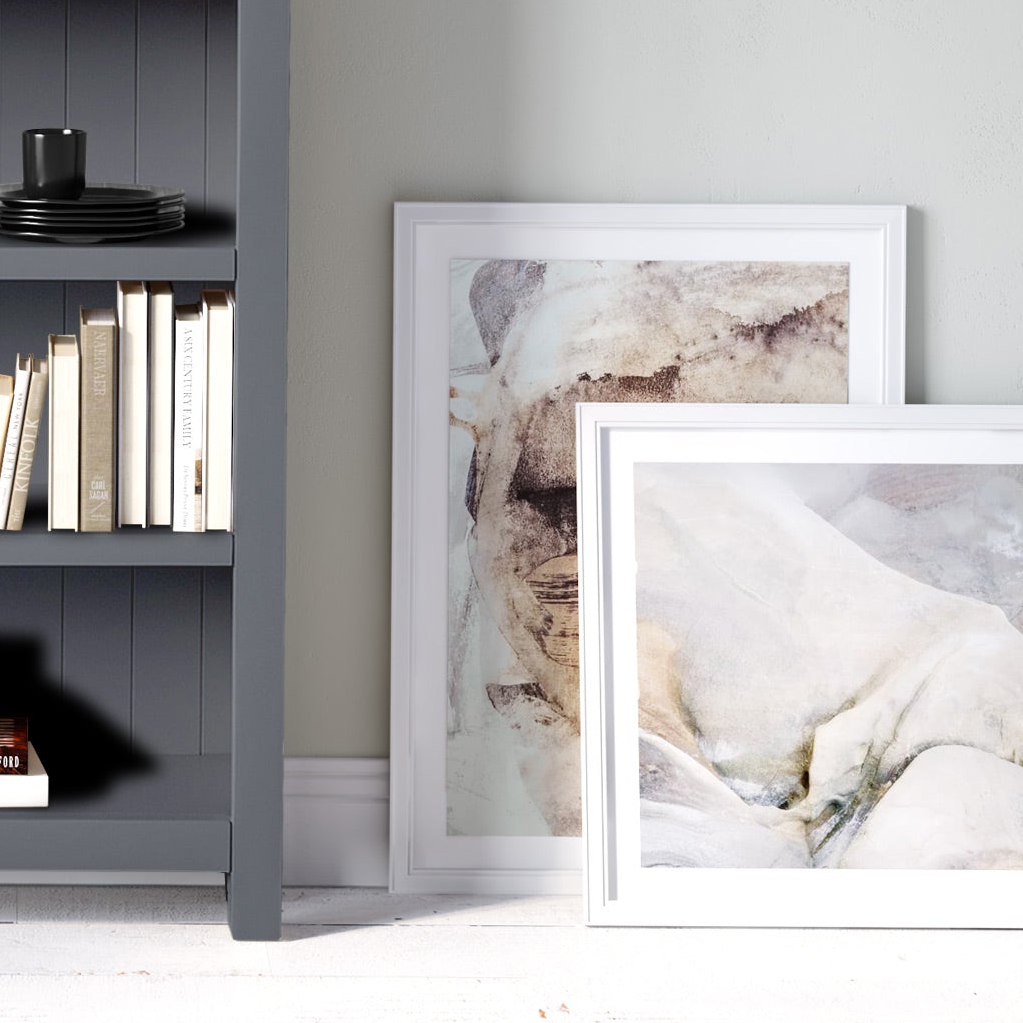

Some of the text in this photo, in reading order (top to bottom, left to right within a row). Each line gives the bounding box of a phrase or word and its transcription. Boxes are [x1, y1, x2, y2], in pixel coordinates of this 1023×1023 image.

[183, 355, 193, 407] CENTURY
[182, 408, 192, 449] FAMILY
[16, 418, 40, 493] KINFOLK
